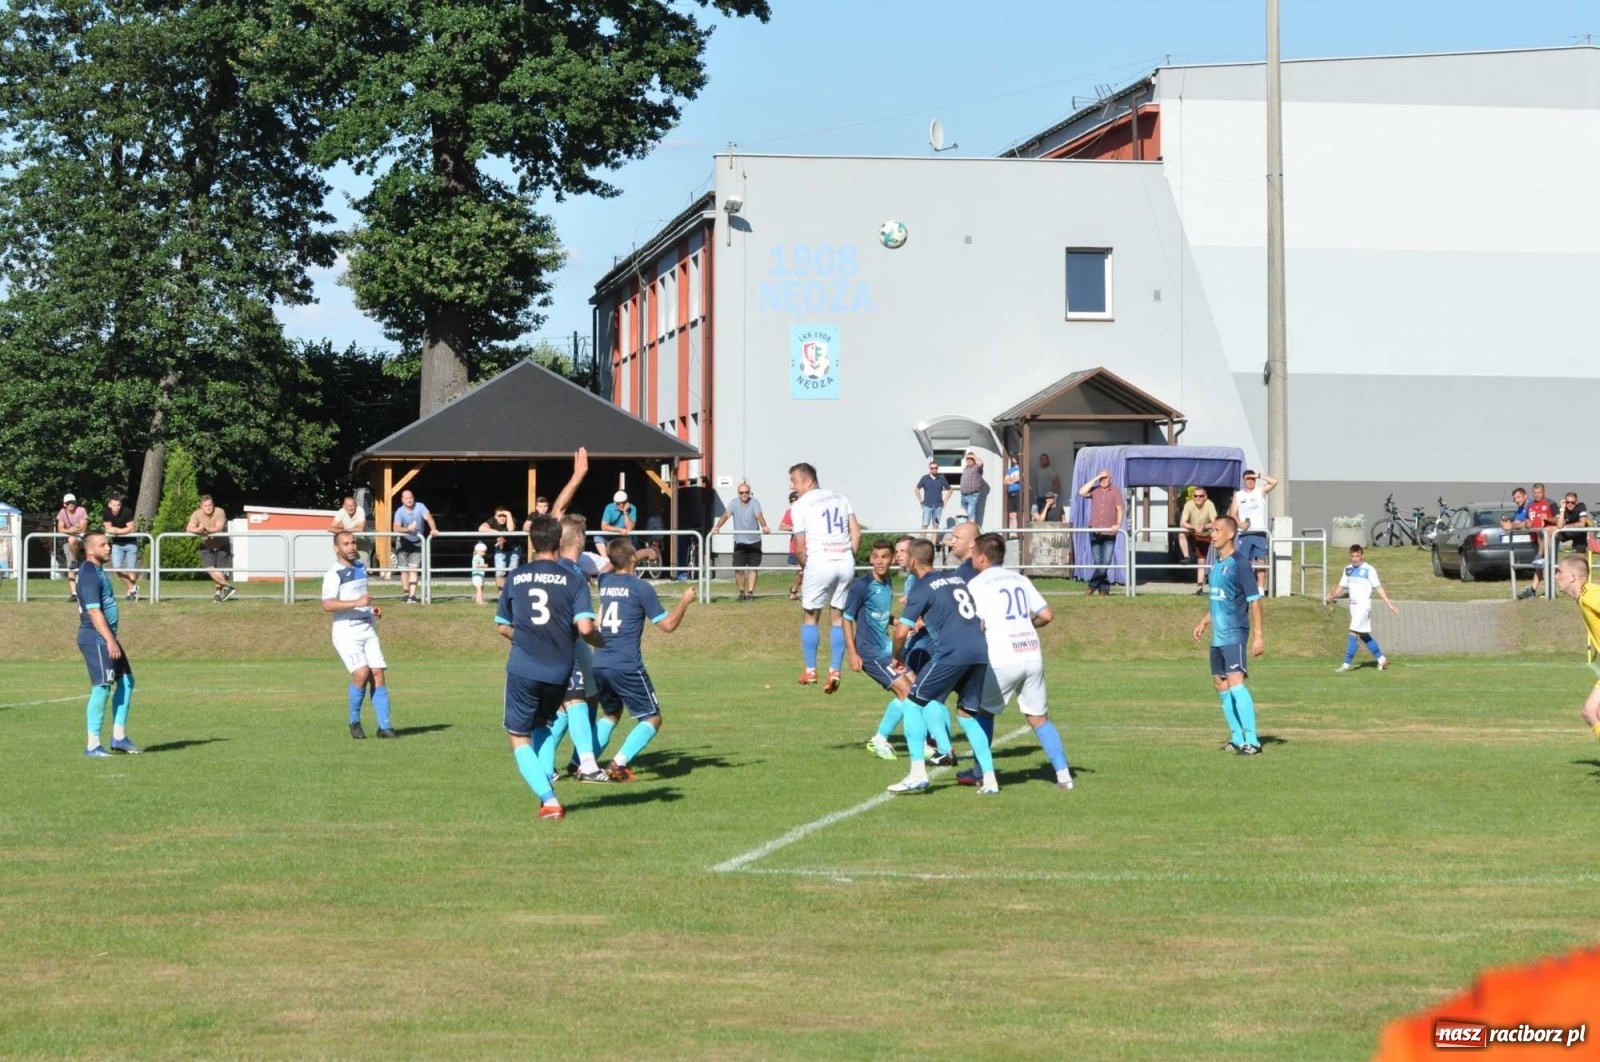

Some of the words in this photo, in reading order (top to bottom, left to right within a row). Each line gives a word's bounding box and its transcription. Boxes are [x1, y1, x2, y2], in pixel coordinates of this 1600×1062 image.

[767, 242, 859, 277] 1908
[821, 507, 844, 534] 14
[513, 572, 533, 586] 1908
[534, 573, 567, 586] NĘDZA
[528, 587, 550, 625] 3
[953, 588, 975, 620] 8
[999, 587, 1028, 620] 20
